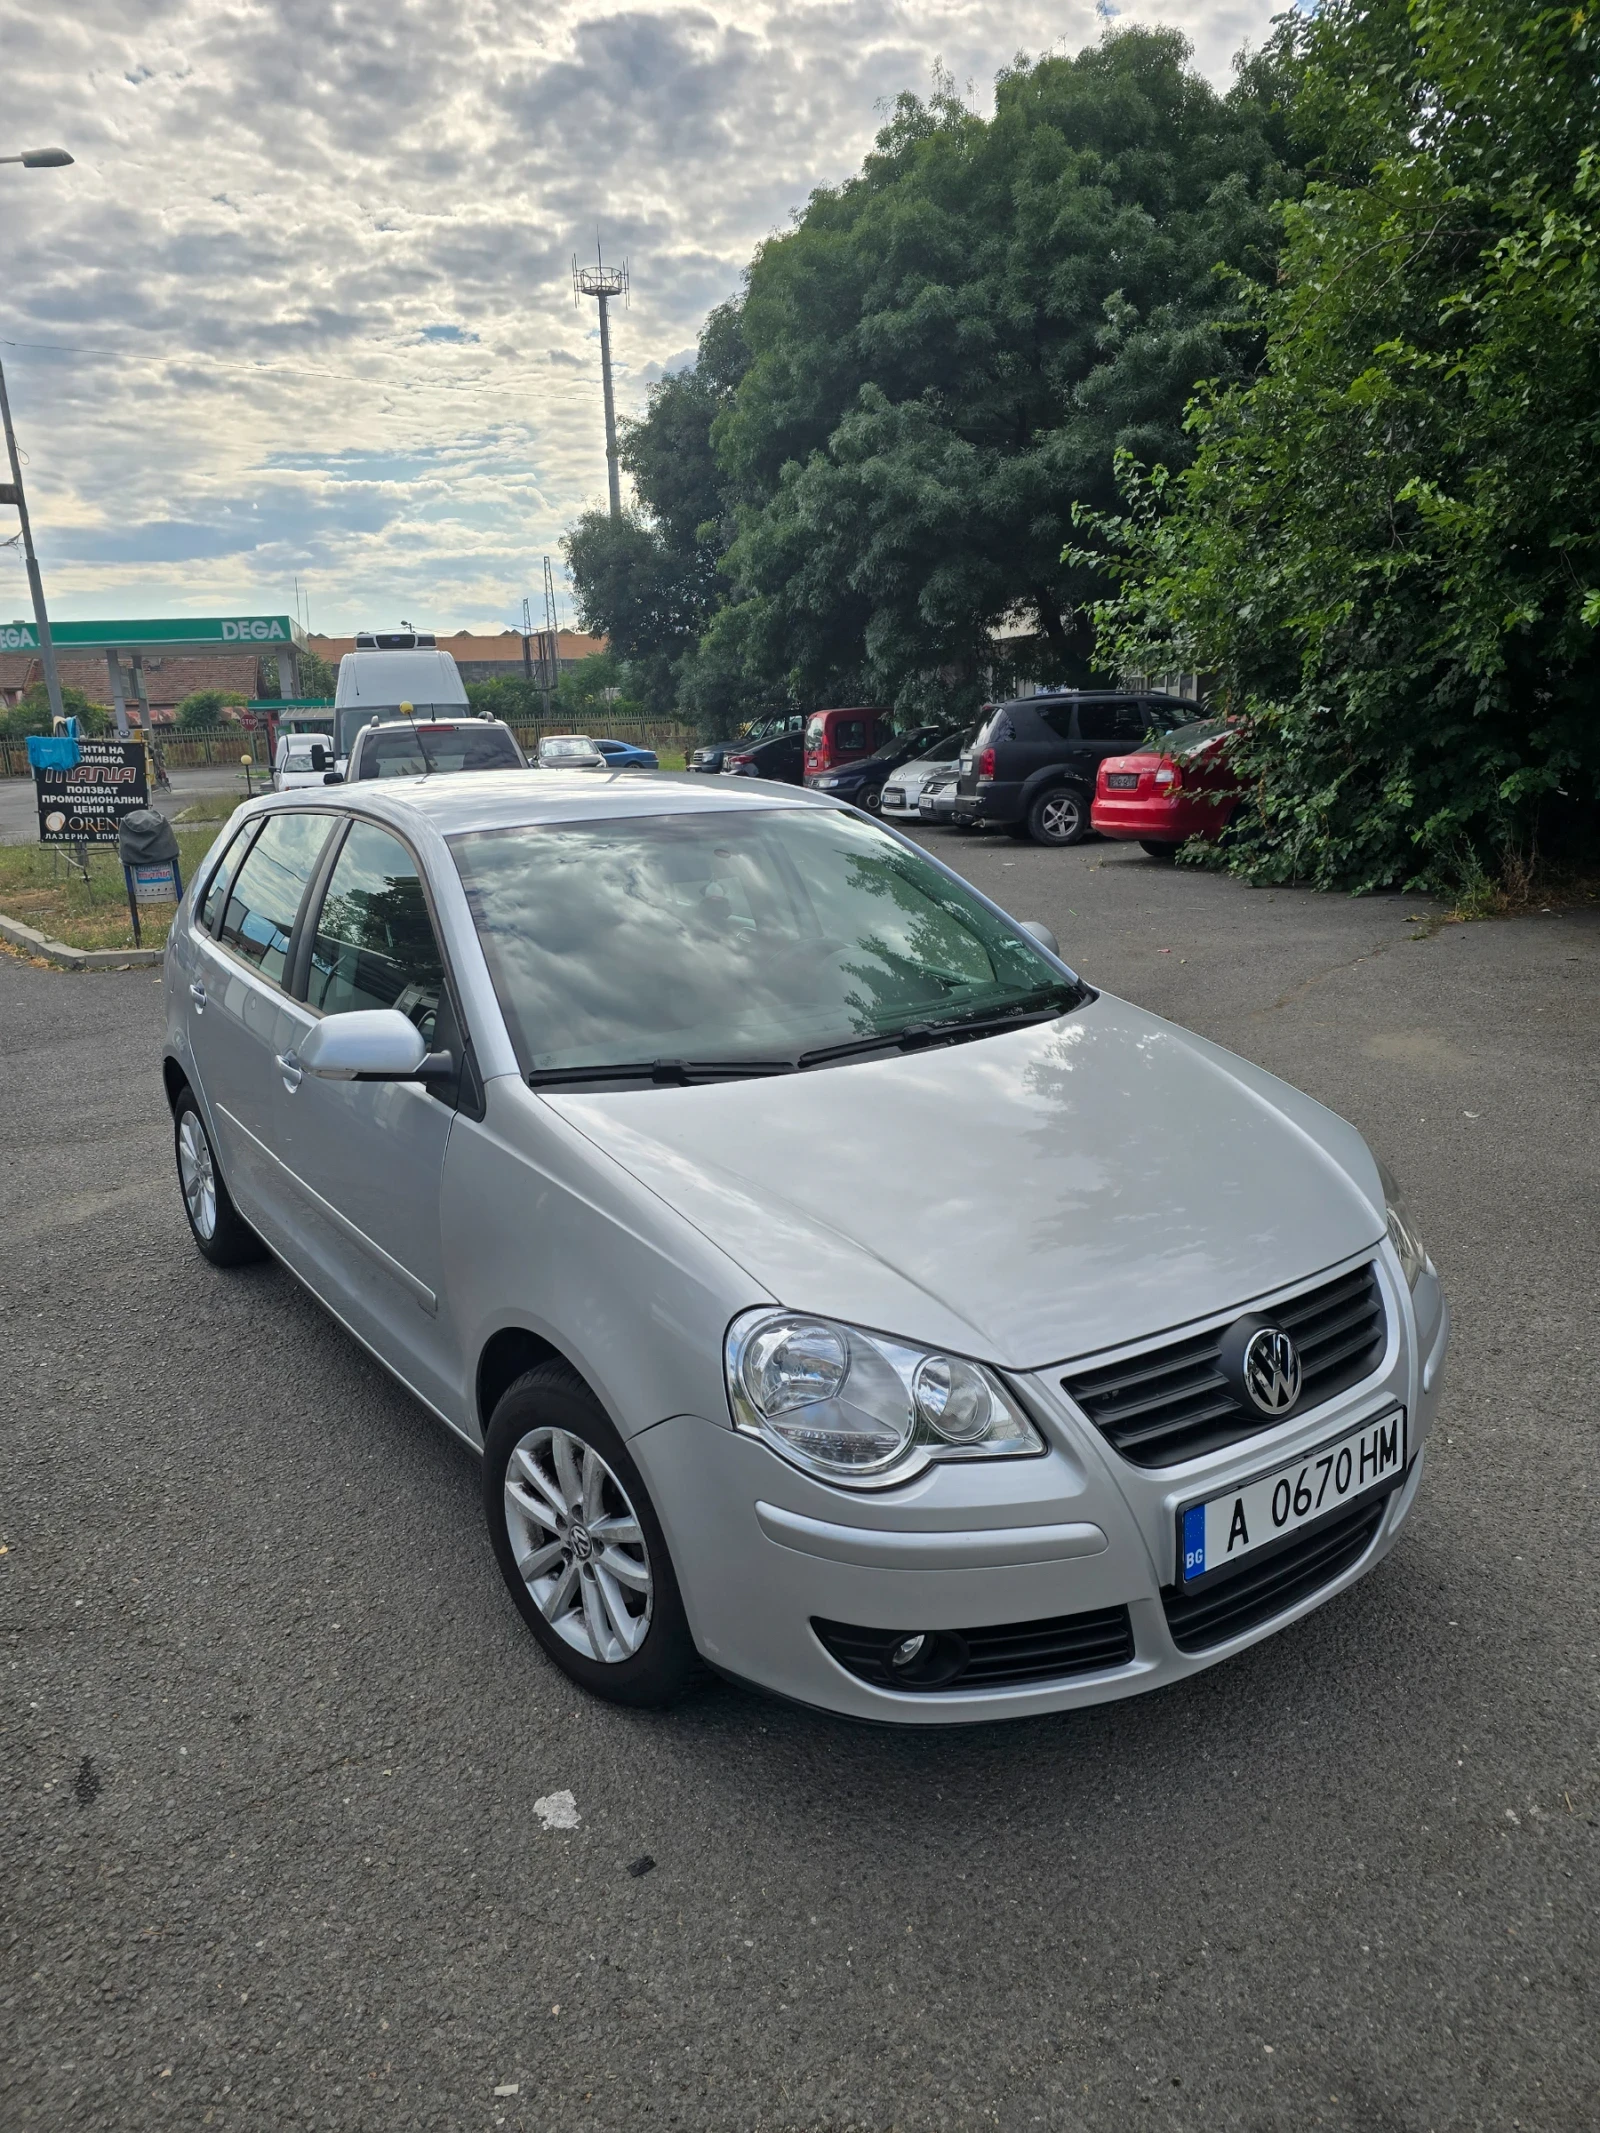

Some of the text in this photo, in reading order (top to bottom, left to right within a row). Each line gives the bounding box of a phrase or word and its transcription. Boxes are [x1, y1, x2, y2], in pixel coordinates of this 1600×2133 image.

[221, 620, 286, 640] DEGA
[108, 745, 125, 754] НА
[66, 786, 119, 795] ПОЛЗВАТ
[42, 795, 144, 805] ПРОМОЦИОНАЛНИ
[73, 805, 115, 814] ЦЕНИ В
[68, 816, 123, 833] OREN
[1227, 1498, 1249, 1552] A
[1271, 1447, 1352, 1528] 0670
[1186, 1548, 1204, 1569] BG
